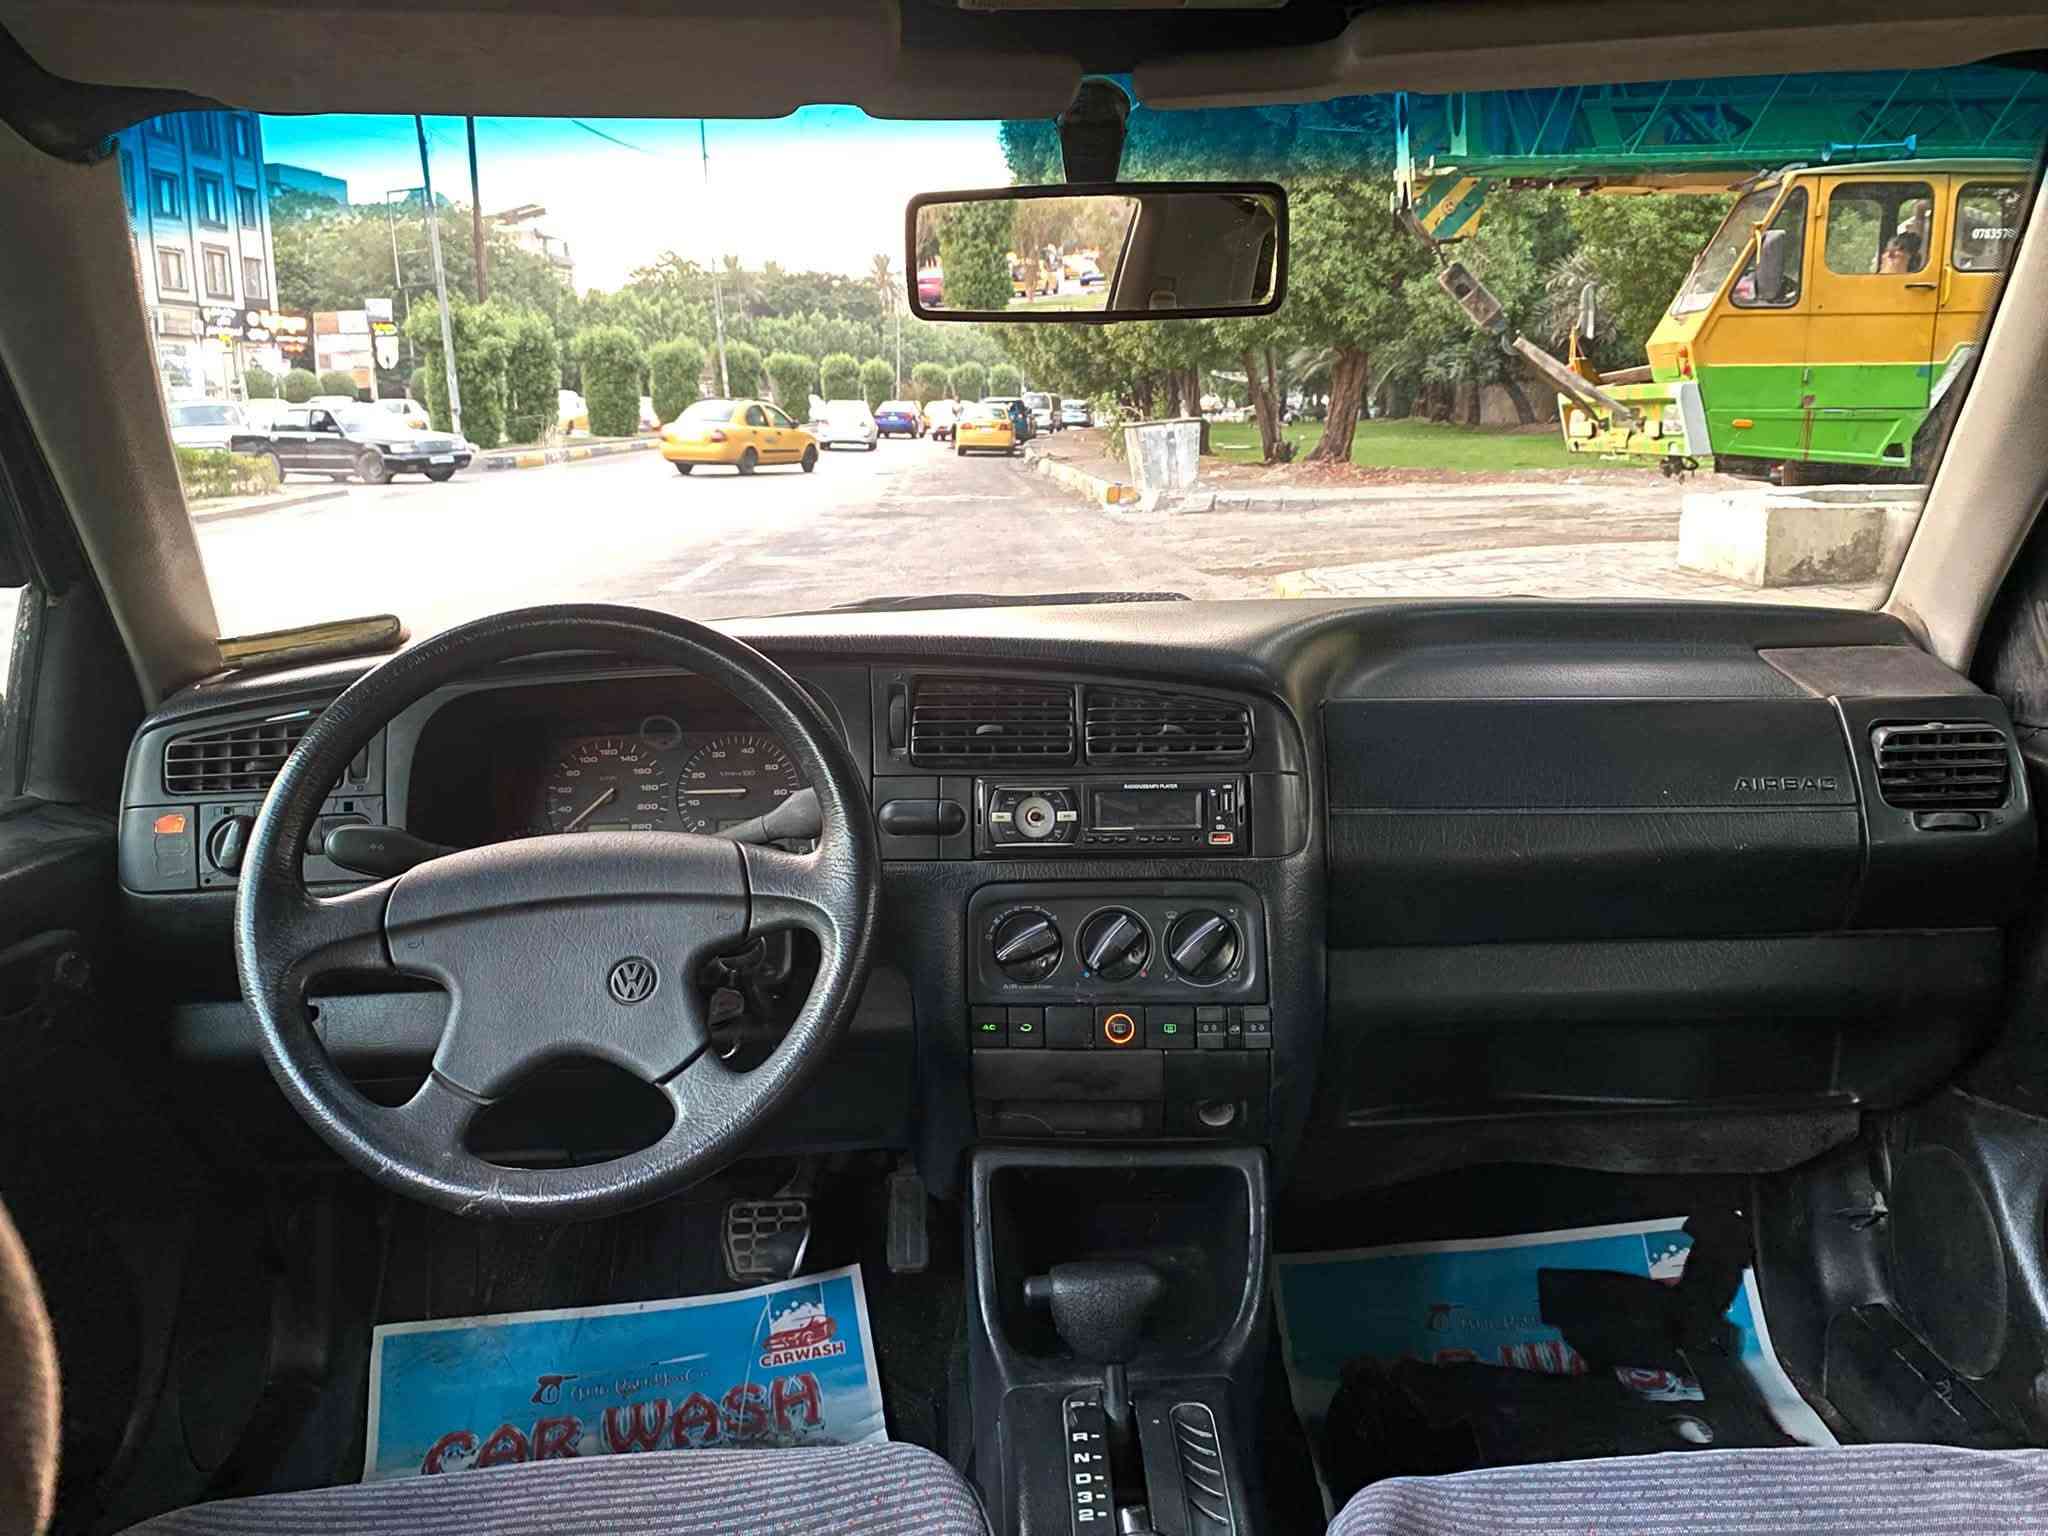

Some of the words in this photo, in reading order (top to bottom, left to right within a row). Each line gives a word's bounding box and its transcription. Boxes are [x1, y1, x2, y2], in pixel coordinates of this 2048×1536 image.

[1734, 777, 1838, 791] AIRBAG
[982, 1023, 996, 1031] AC
[760, 1342, 845, 1367] CARWASH
[421, 1418, 583, 1474] CAR
[603, 1371, 826, 1453] WASH
[1072, 1432, 1088, 1442] R
[1074, 1453, 1090, 1464] N
[1075, 1473, 1092, 1484] D
[1077, 1491, 1093, 1503] 3
[1078, 1508, 1094, 1521] 2
